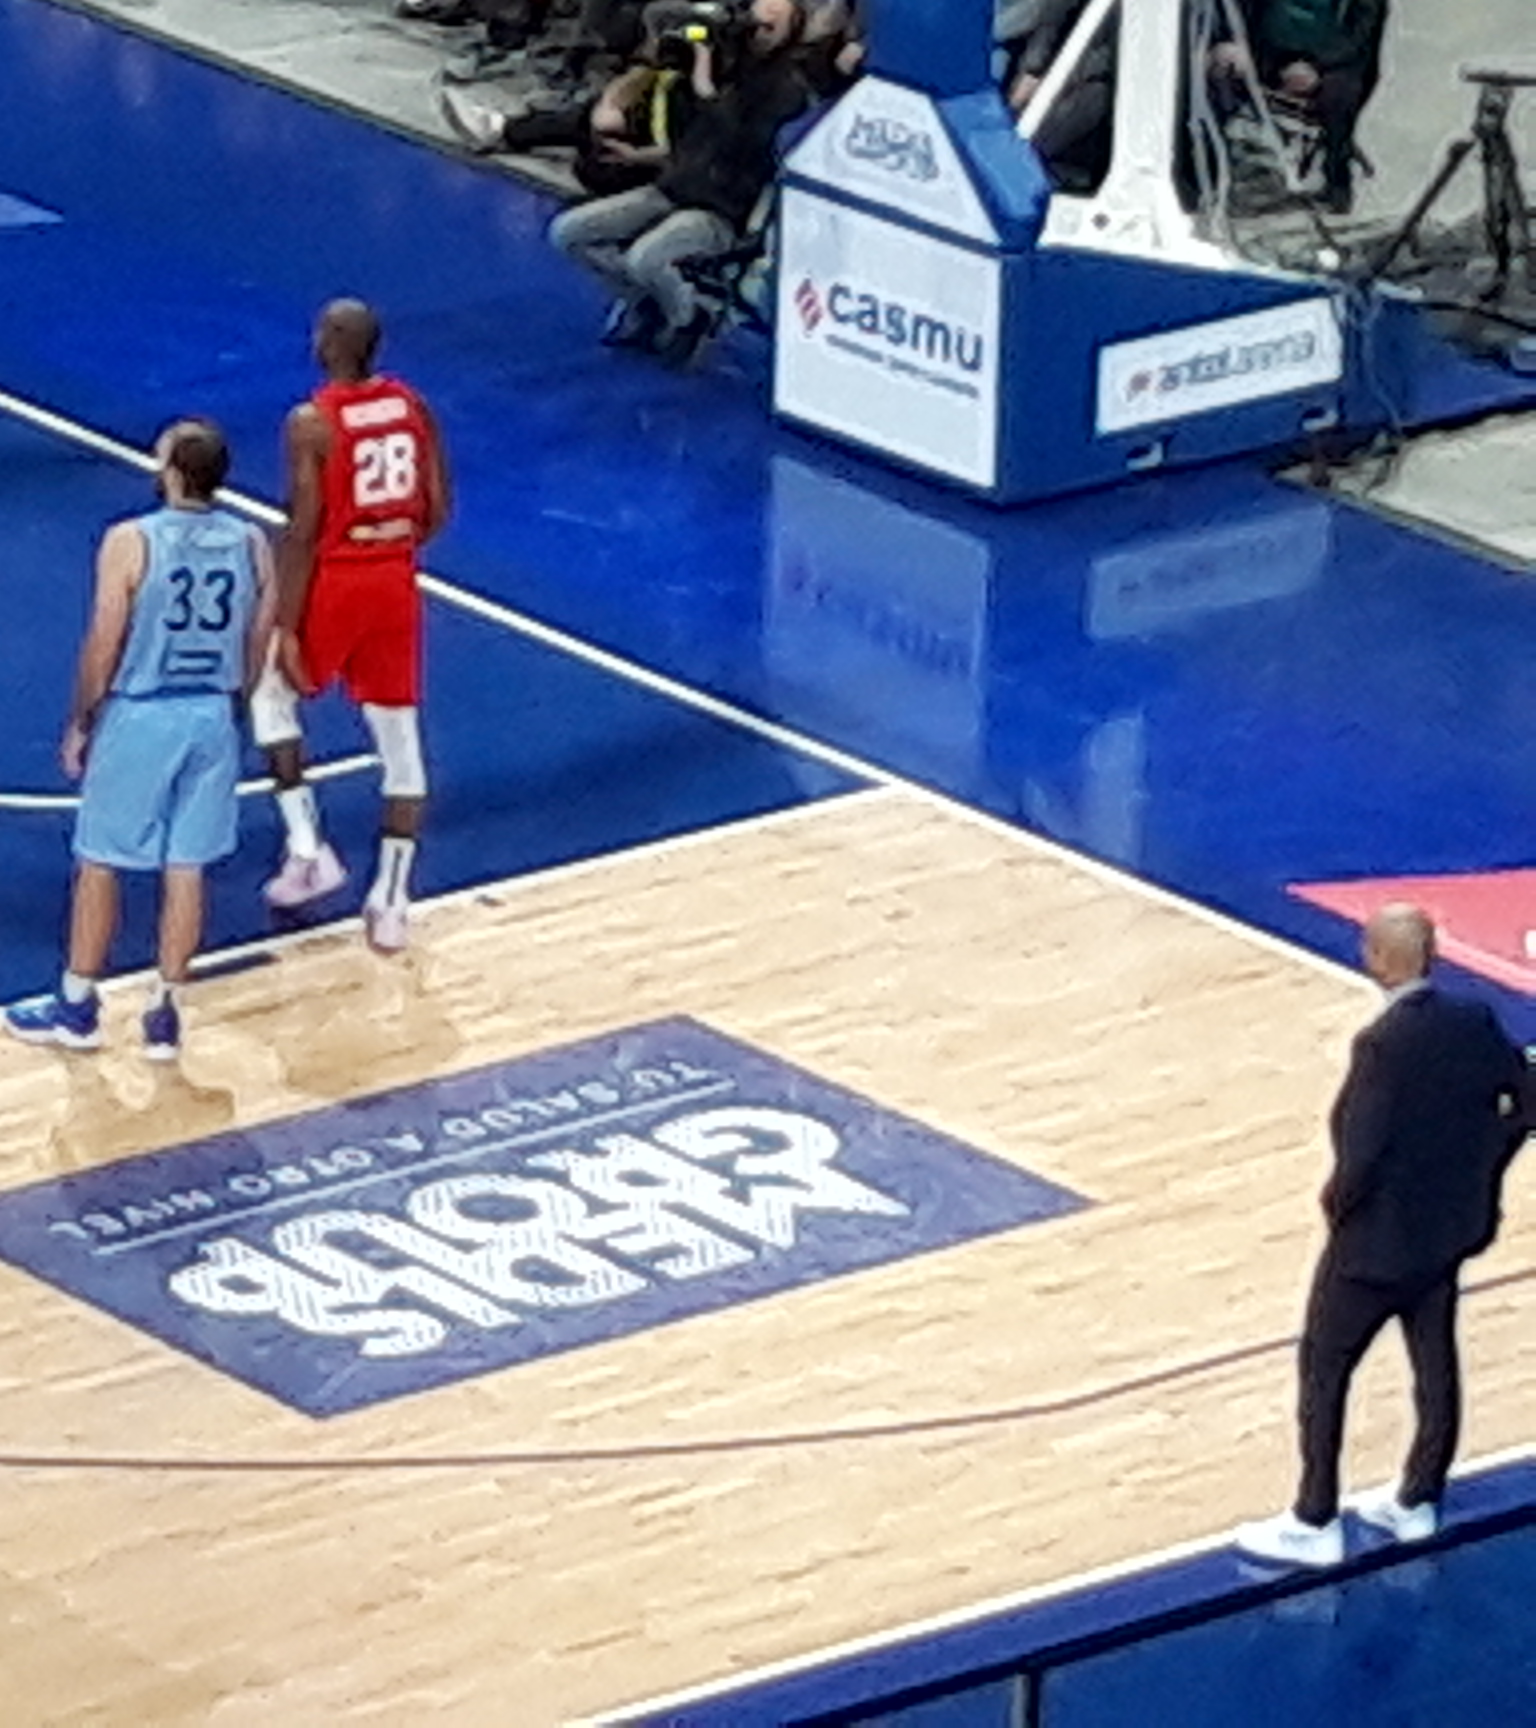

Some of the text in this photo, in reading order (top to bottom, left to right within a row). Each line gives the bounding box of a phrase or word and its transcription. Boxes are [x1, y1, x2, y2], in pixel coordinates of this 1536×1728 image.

[827, 283, 984, 373] casmu
[354, 433, 416, 507] 28
[163, 566, 235, 632] 33
[48, 1060, 719, 1239] TU SALUD A OTRO NIVEL
[168, 1106, 842, 1317] GROUP
